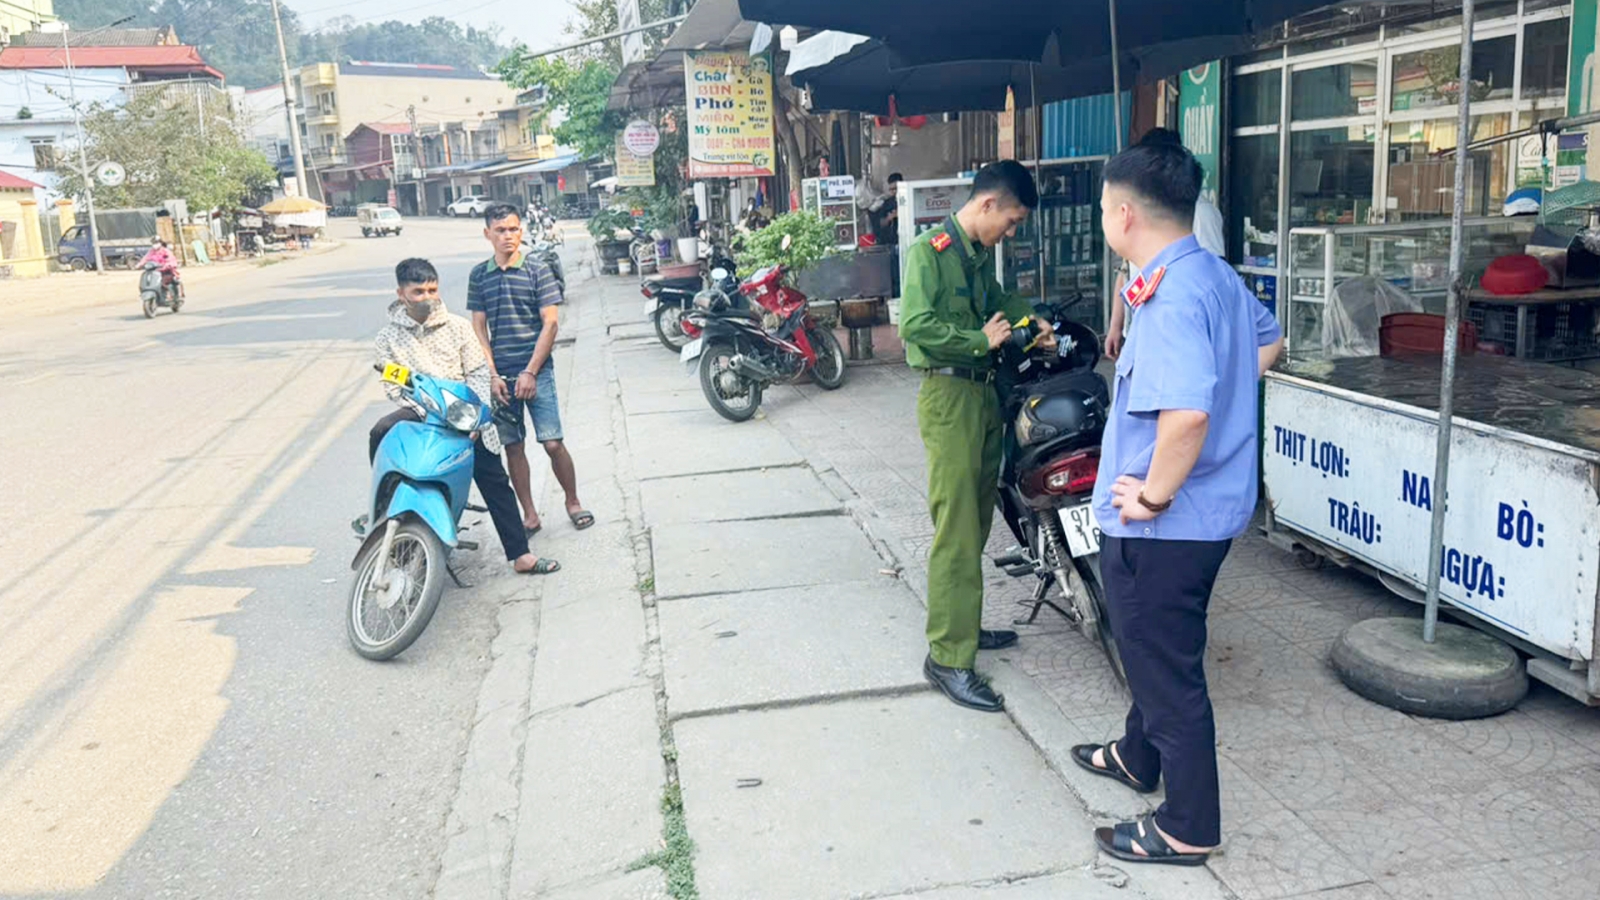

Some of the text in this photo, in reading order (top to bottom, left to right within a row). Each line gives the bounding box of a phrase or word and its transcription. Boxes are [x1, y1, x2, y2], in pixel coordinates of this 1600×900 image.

[390, 368, 400, 380] 4
[1274, 425, 1350, 478] THỊT LỢN:
[1071, 506, 1090, 527] 97
[1328, 497, 1382, 545] TRÂU:
[1497, 499, 1545, 548] BÒ:
